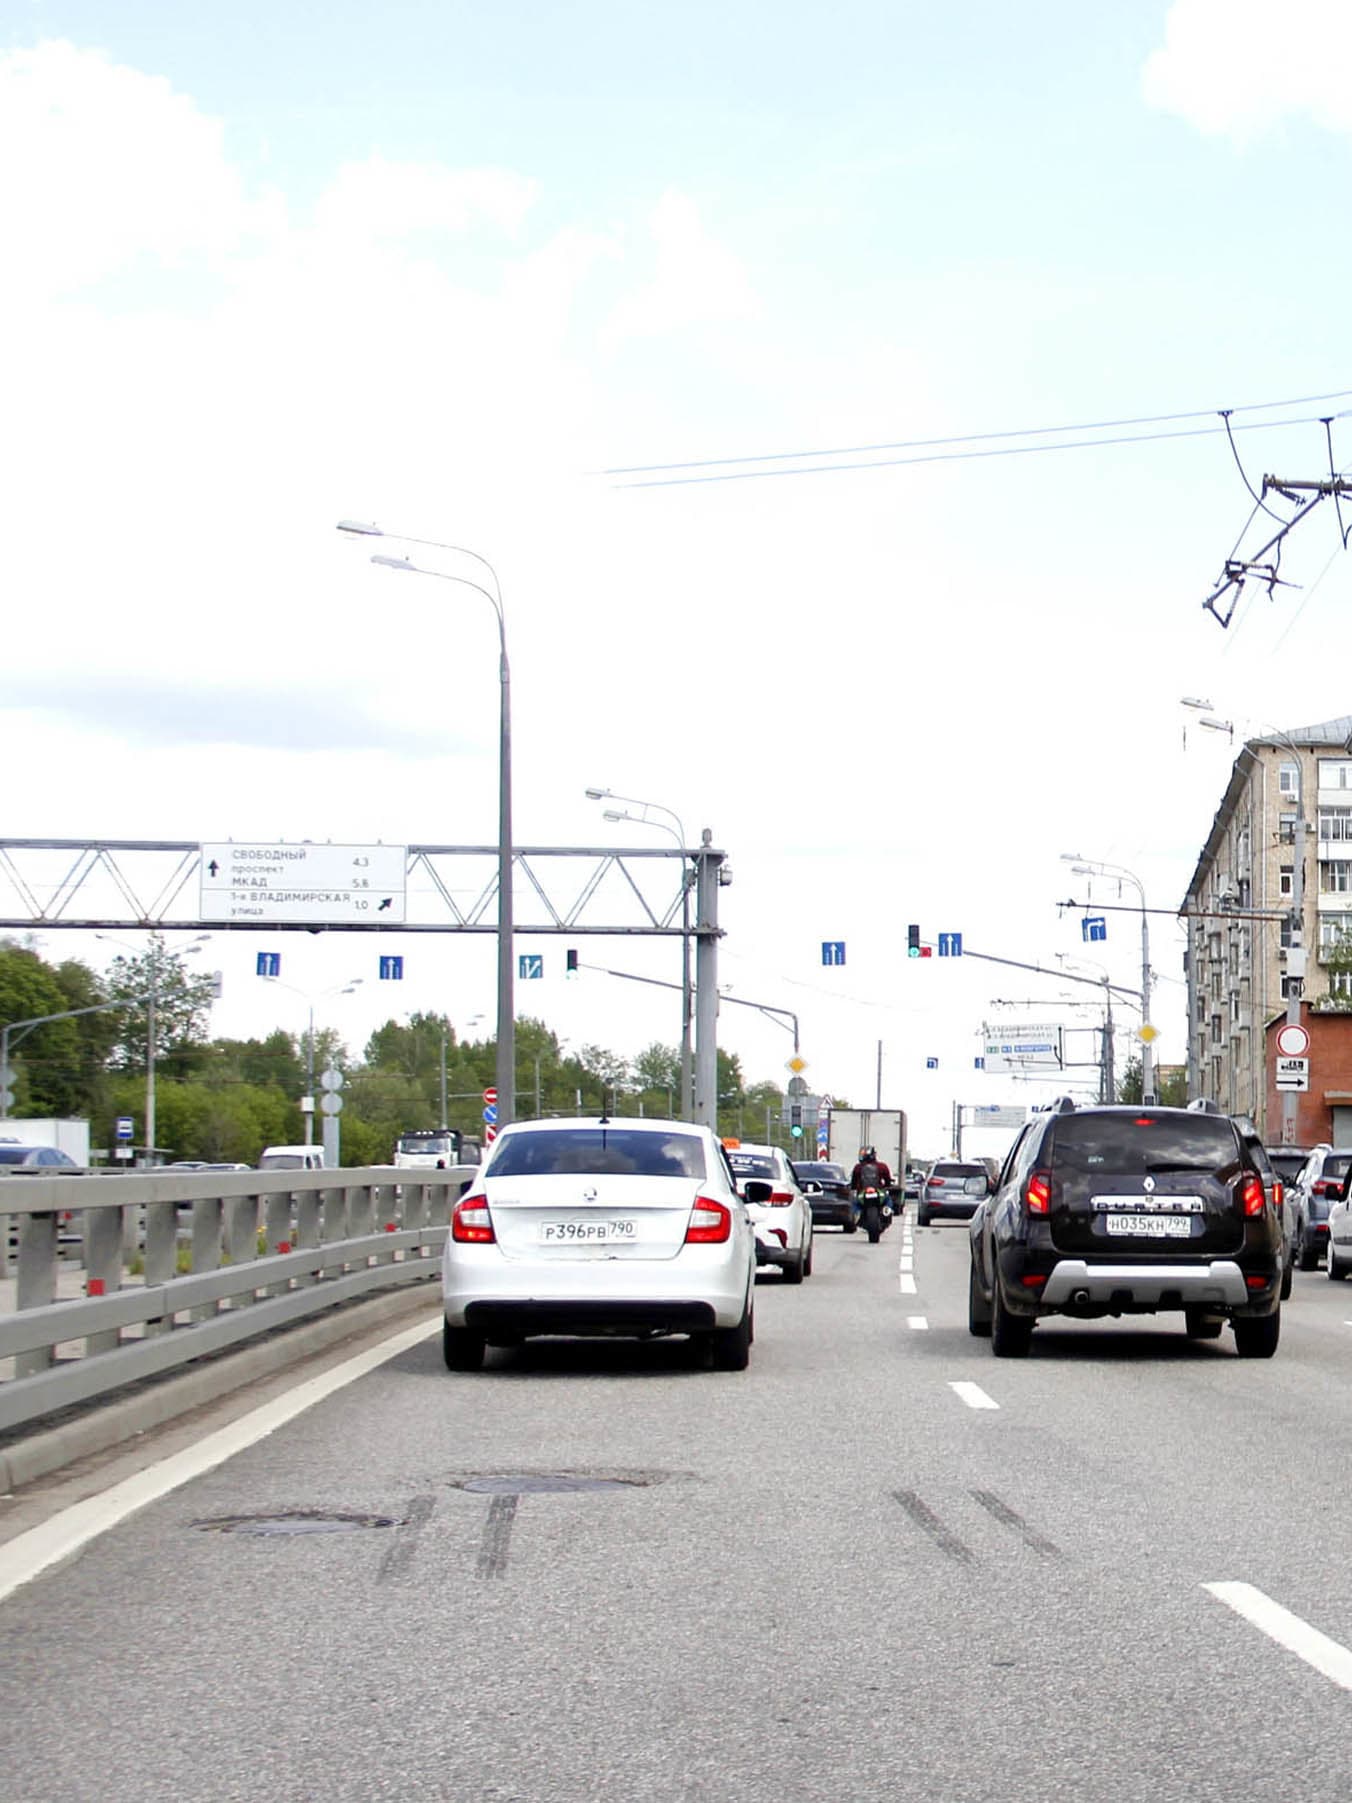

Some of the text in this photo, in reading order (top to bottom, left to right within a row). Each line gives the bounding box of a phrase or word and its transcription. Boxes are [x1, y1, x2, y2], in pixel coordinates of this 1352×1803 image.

[232, 848, 306, 860] СВОБОДНЫЙ
[232, 865, 284, 874] проспект
[232, 877, 268, 887] МКАД
